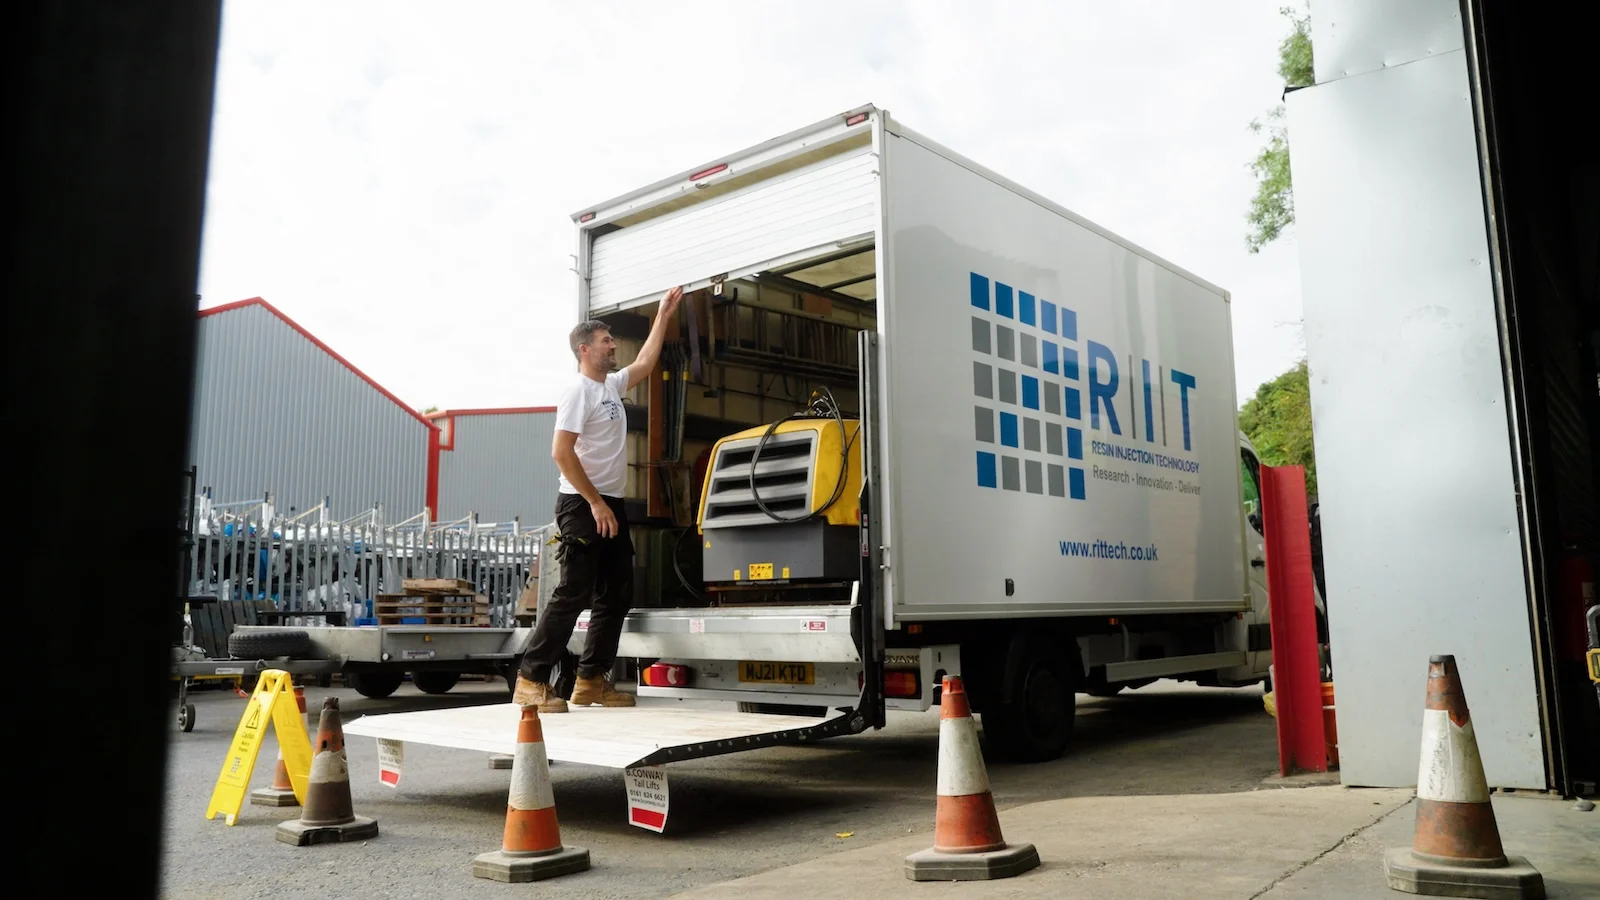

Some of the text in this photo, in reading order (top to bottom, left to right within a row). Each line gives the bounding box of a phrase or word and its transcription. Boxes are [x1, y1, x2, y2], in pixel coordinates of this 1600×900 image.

[1092, 440, 1200, 474] RESIN INJECTION TECHNOLOGY
[1093, 465, 1130, 483] Research
[1136, 473, 1173, 491] Innovation
[1178, 480, 1201, 496] Deliver
[1059, 539, 1158, 561] www.rittech.co.uk
[746, 663, 806, 682] MJ21 KTD
[626, 769, 663, 780] B.CONWAY
[634, 779, 660, 790] Tail Lifts
